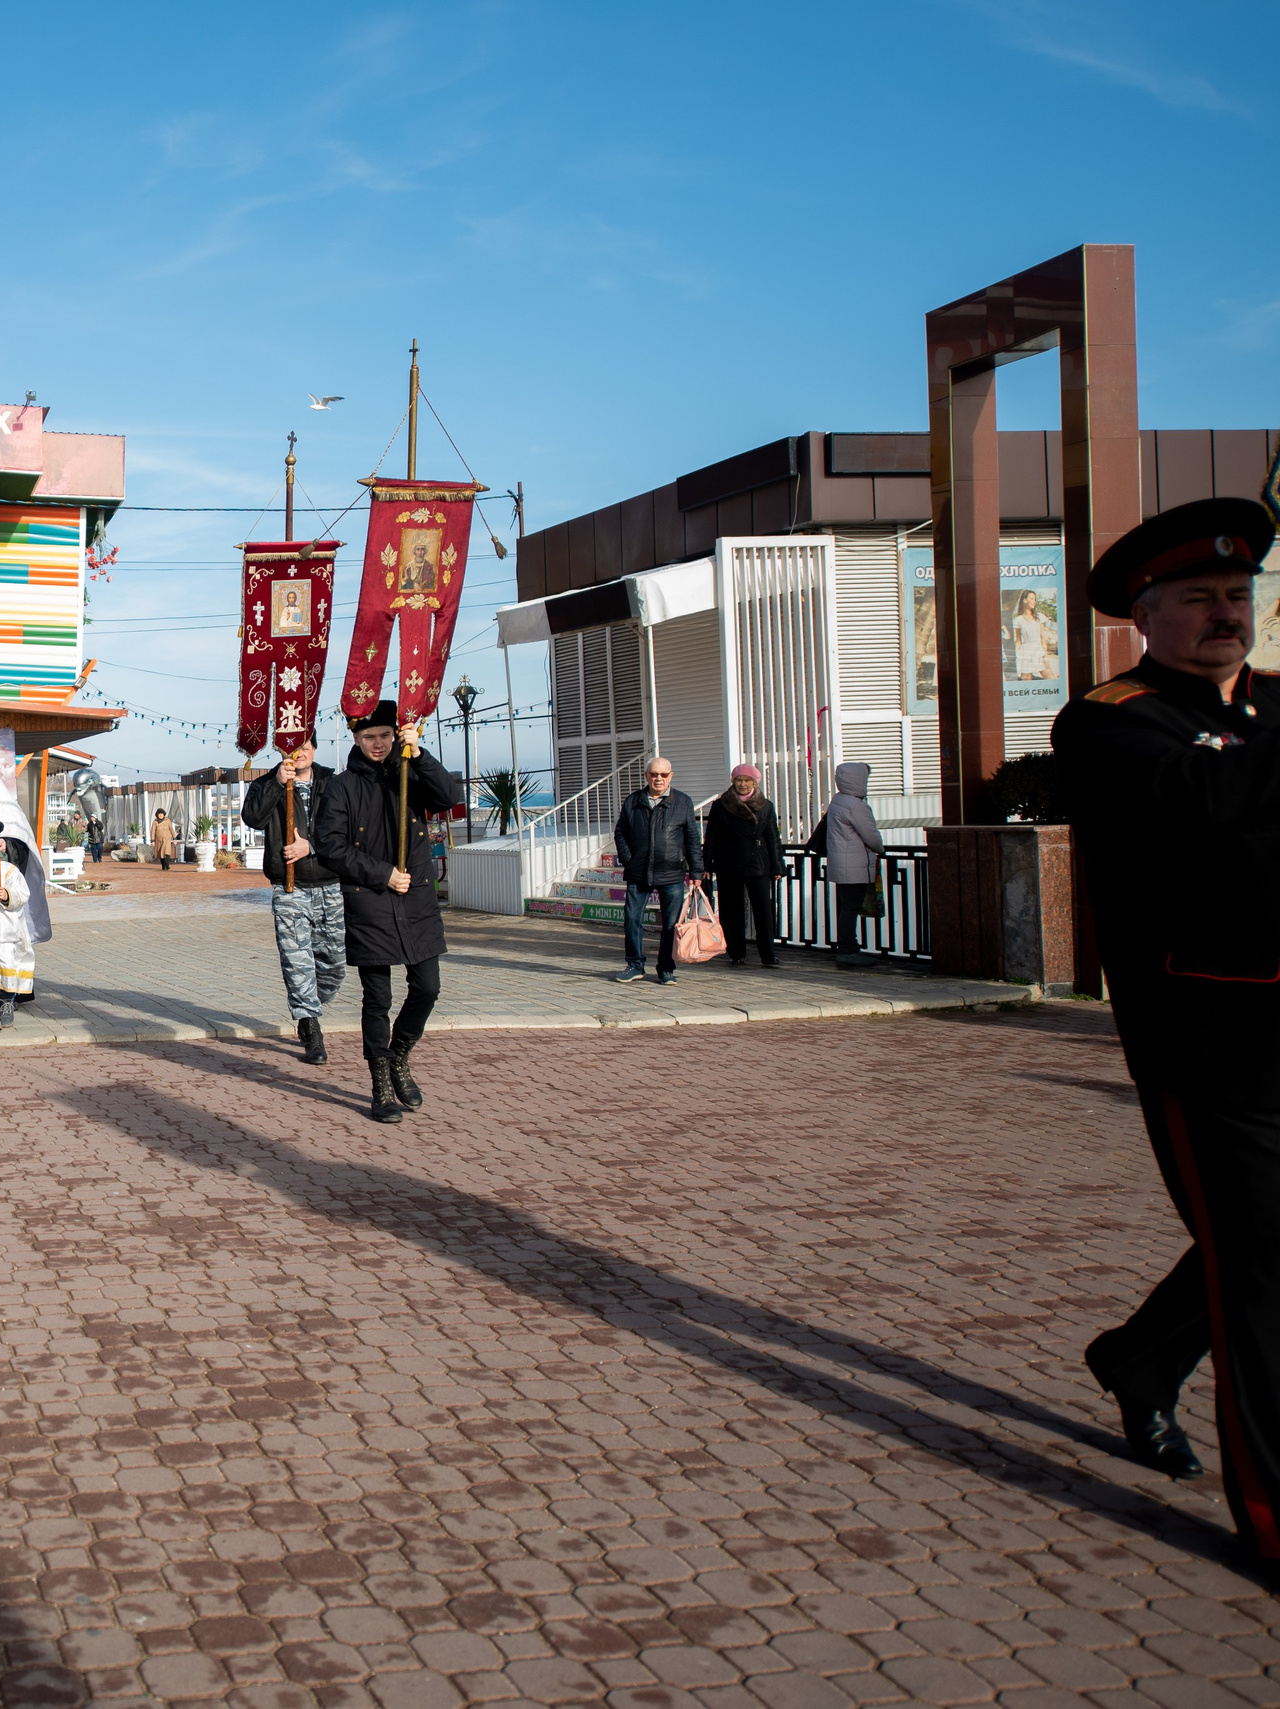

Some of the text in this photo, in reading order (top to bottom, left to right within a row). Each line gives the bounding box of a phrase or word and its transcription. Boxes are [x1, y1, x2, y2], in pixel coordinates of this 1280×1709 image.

[1000, 563, 1057, 578] ХЛОПКА
[1008, 687, 1059, 697] ВСЕЙ СЕМЬИ
[595, 907, 612, 919] MINI
[612, 908, 625, 921] FIX
